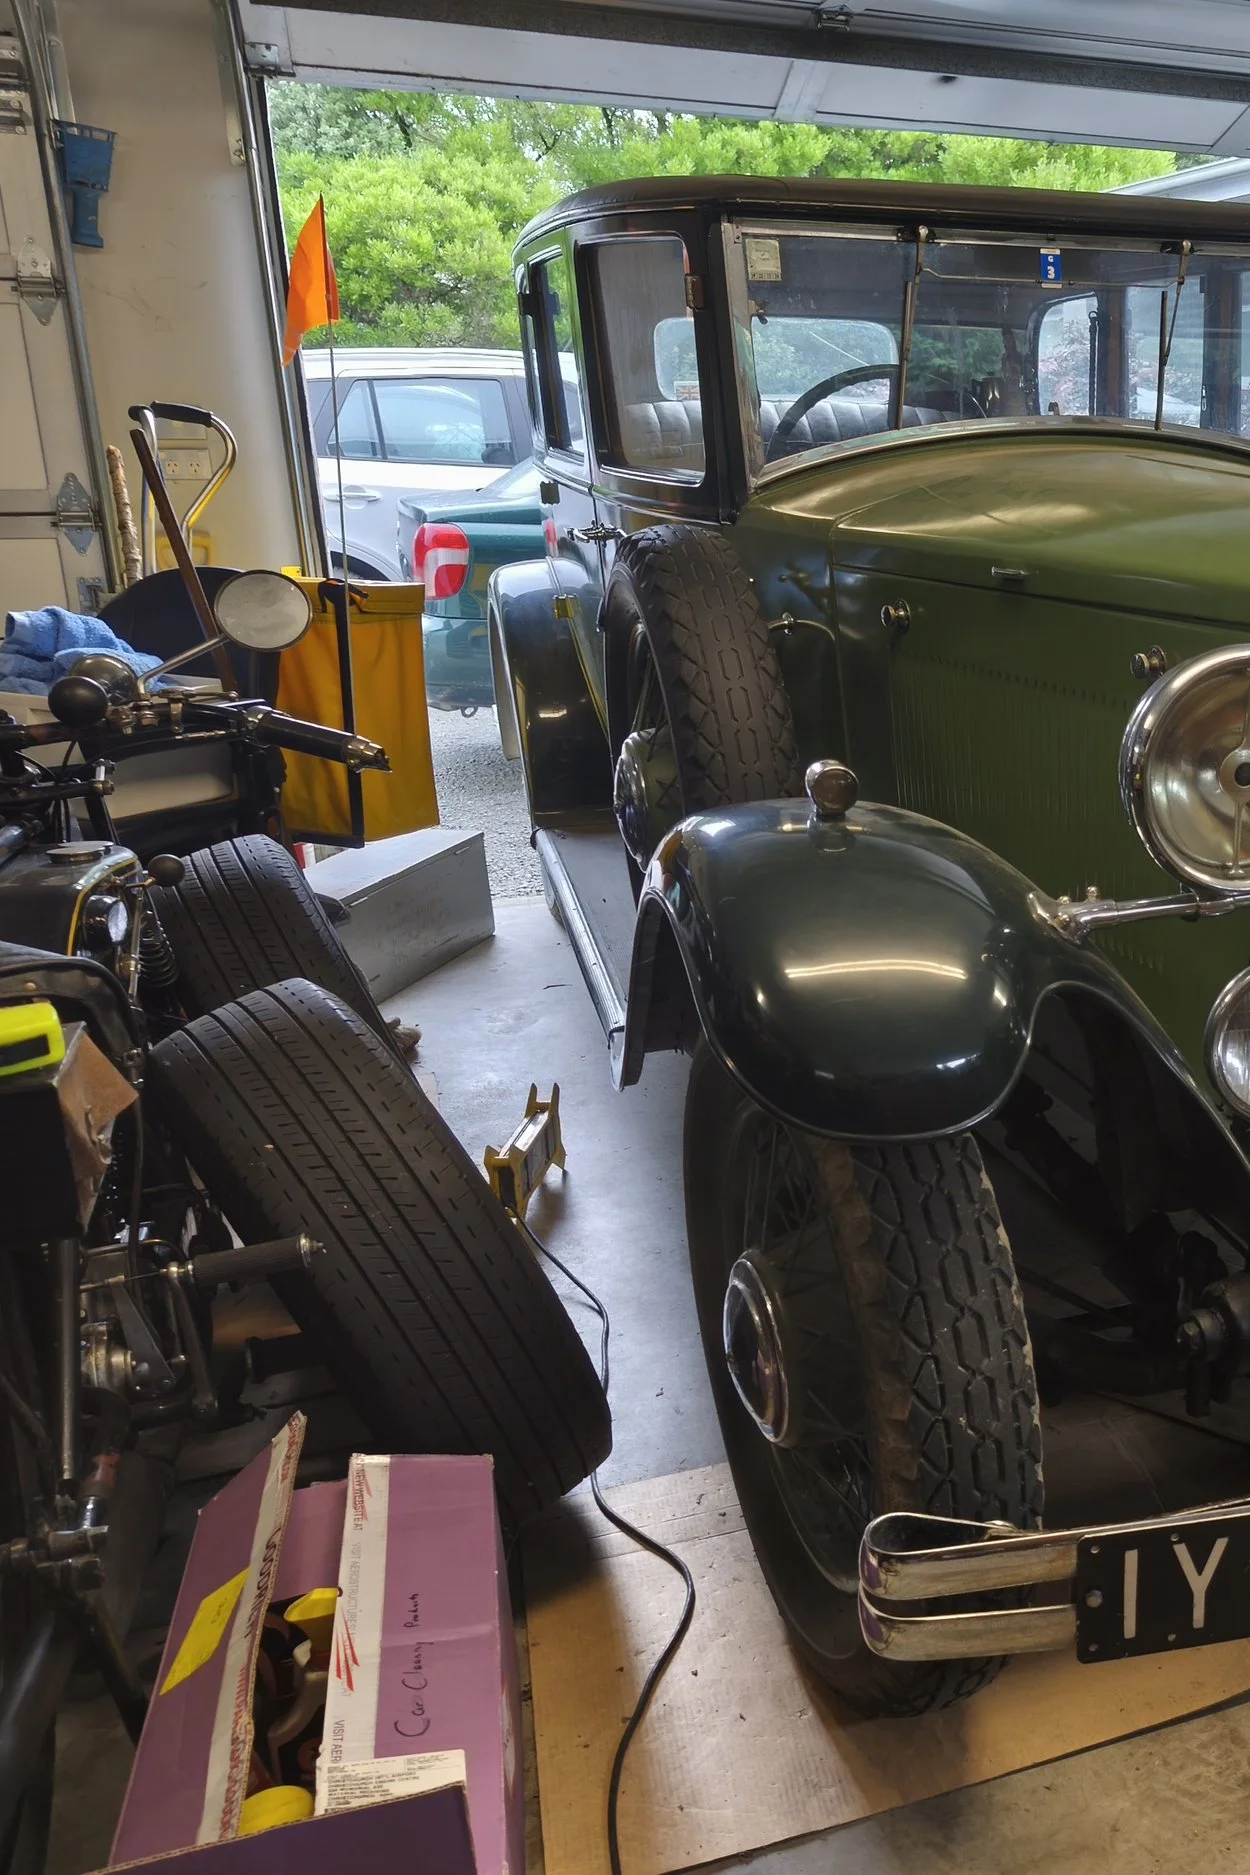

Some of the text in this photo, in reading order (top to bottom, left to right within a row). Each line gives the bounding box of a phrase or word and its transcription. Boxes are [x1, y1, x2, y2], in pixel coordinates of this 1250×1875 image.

[1047, 266, 1055, 279] 3
[355, 1468, 365, 1487] NEW
[353, 1487, 364, 1521] WEBSITE
[403, 1593, 420, 1628] Products
[332, 1720, 345, 1742] VISIT
[394, 1702, 431, 1737] Car
